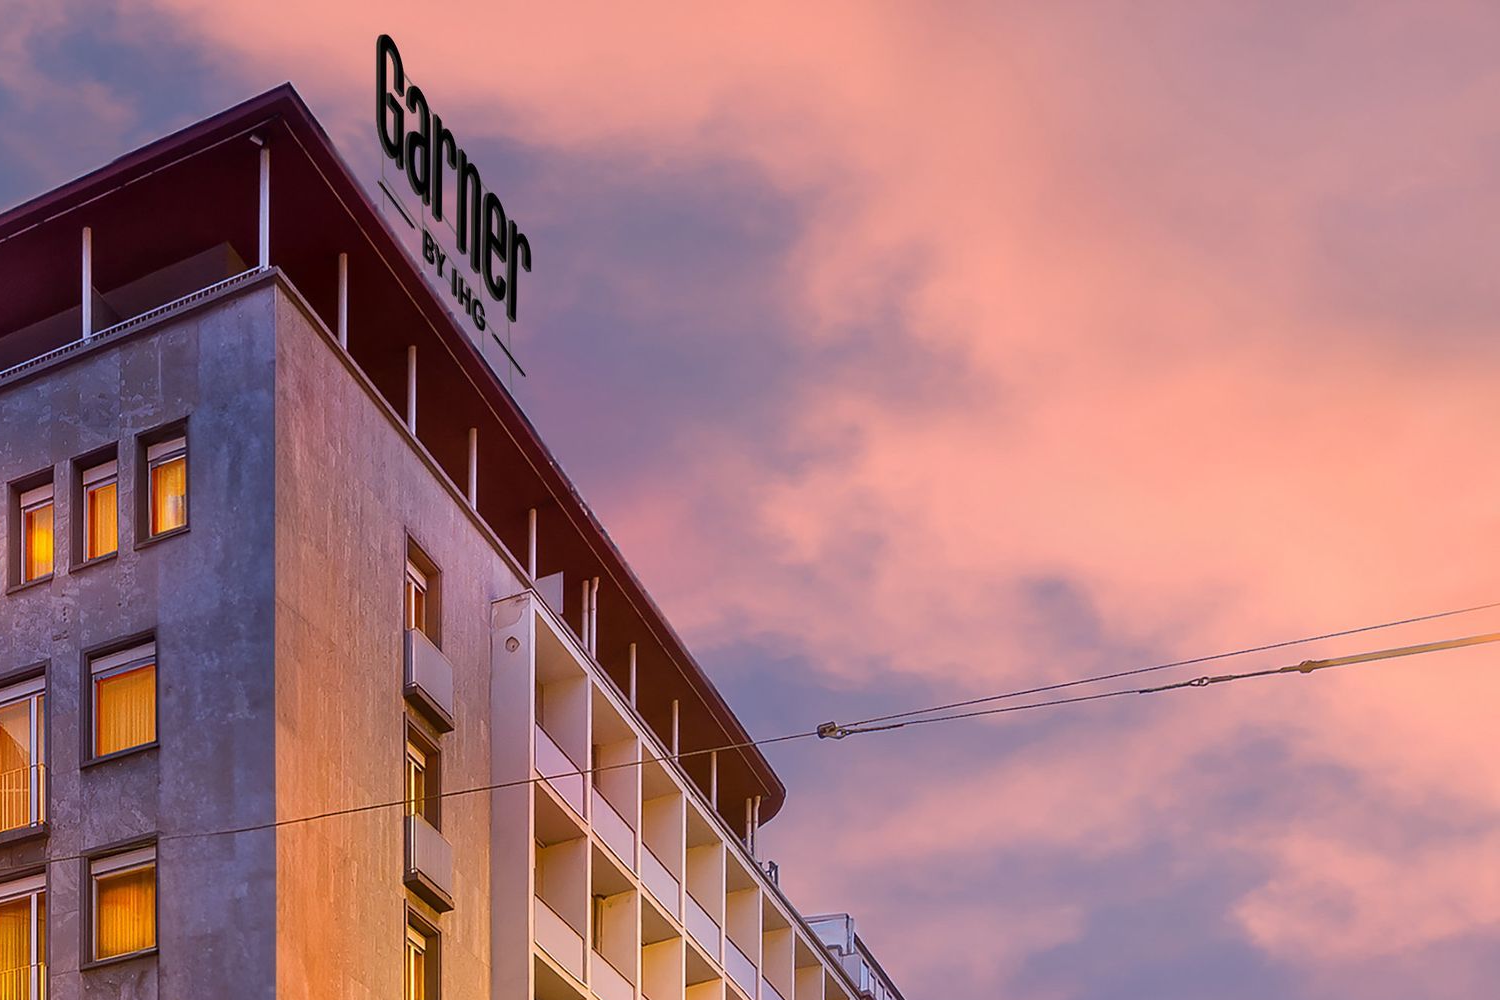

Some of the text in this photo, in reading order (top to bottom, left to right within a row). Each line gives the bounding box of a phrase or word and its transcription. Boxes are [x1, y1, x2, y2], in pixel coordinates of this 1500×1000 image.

[376, 34, 532, 322] Garner
[422, 229, 486, 331] BY IHG
